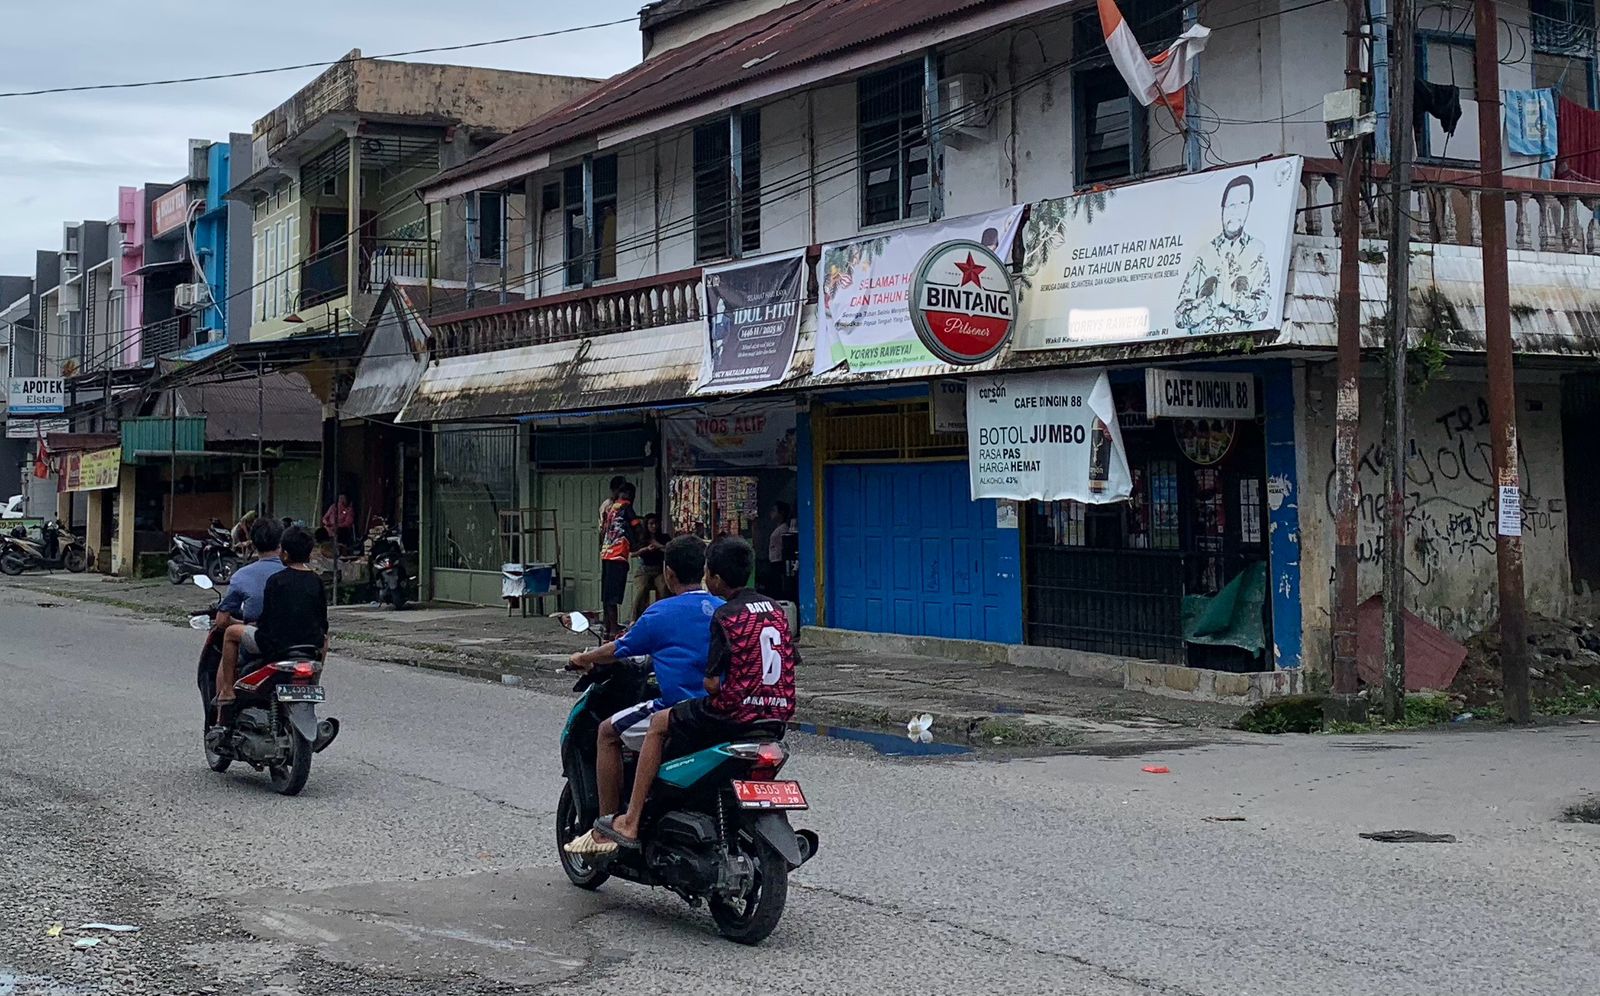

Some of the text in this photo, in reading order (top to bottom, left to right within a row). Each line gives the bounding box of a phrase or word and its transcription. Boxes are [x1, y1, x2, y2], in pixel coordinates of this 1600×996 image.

[1072, 235, 1183, 260] SELAMAT HARI NATAL
[1064, 253, 1182, 278] DAN TAHUN BARU 2025
[859, 274, 899, 291] SELAMAT
[850, 294, 871, 307] DAN
[873, 290, 902, 305] TAHUN
[927, 287, 1009, 316] BINTANG
[734, 307, 762, 324] IDUL
[944, 317, 990, 337] Pilsener
[1045, 336, 1061, 345] Wakil
[879, 344, 912, 358] RAWEYAI
[23, 380, 63, 394] APOTEK
[940, 383, 967, 394] TOK
[1165, 379, 1193, 407] CAFE
[1236, 382, 1248, 409] 88
[26, 394, 56, 404] Elstar
[1014, 396, 1082, 409] CAFE DINGIN 88
[734, 416, 767, 433] ALIF
[979, 424, 1086, 446] BOTOL JUMBO
[979, 448, 1021, 460] RASA PAS
[979, 460, 1041, 473] HARGA HEMAT
[745, 601, 774, 614] BAYU
[760, 626, 782, 686] 6
[736, 783, 799, 795] PA 6505 HZ
